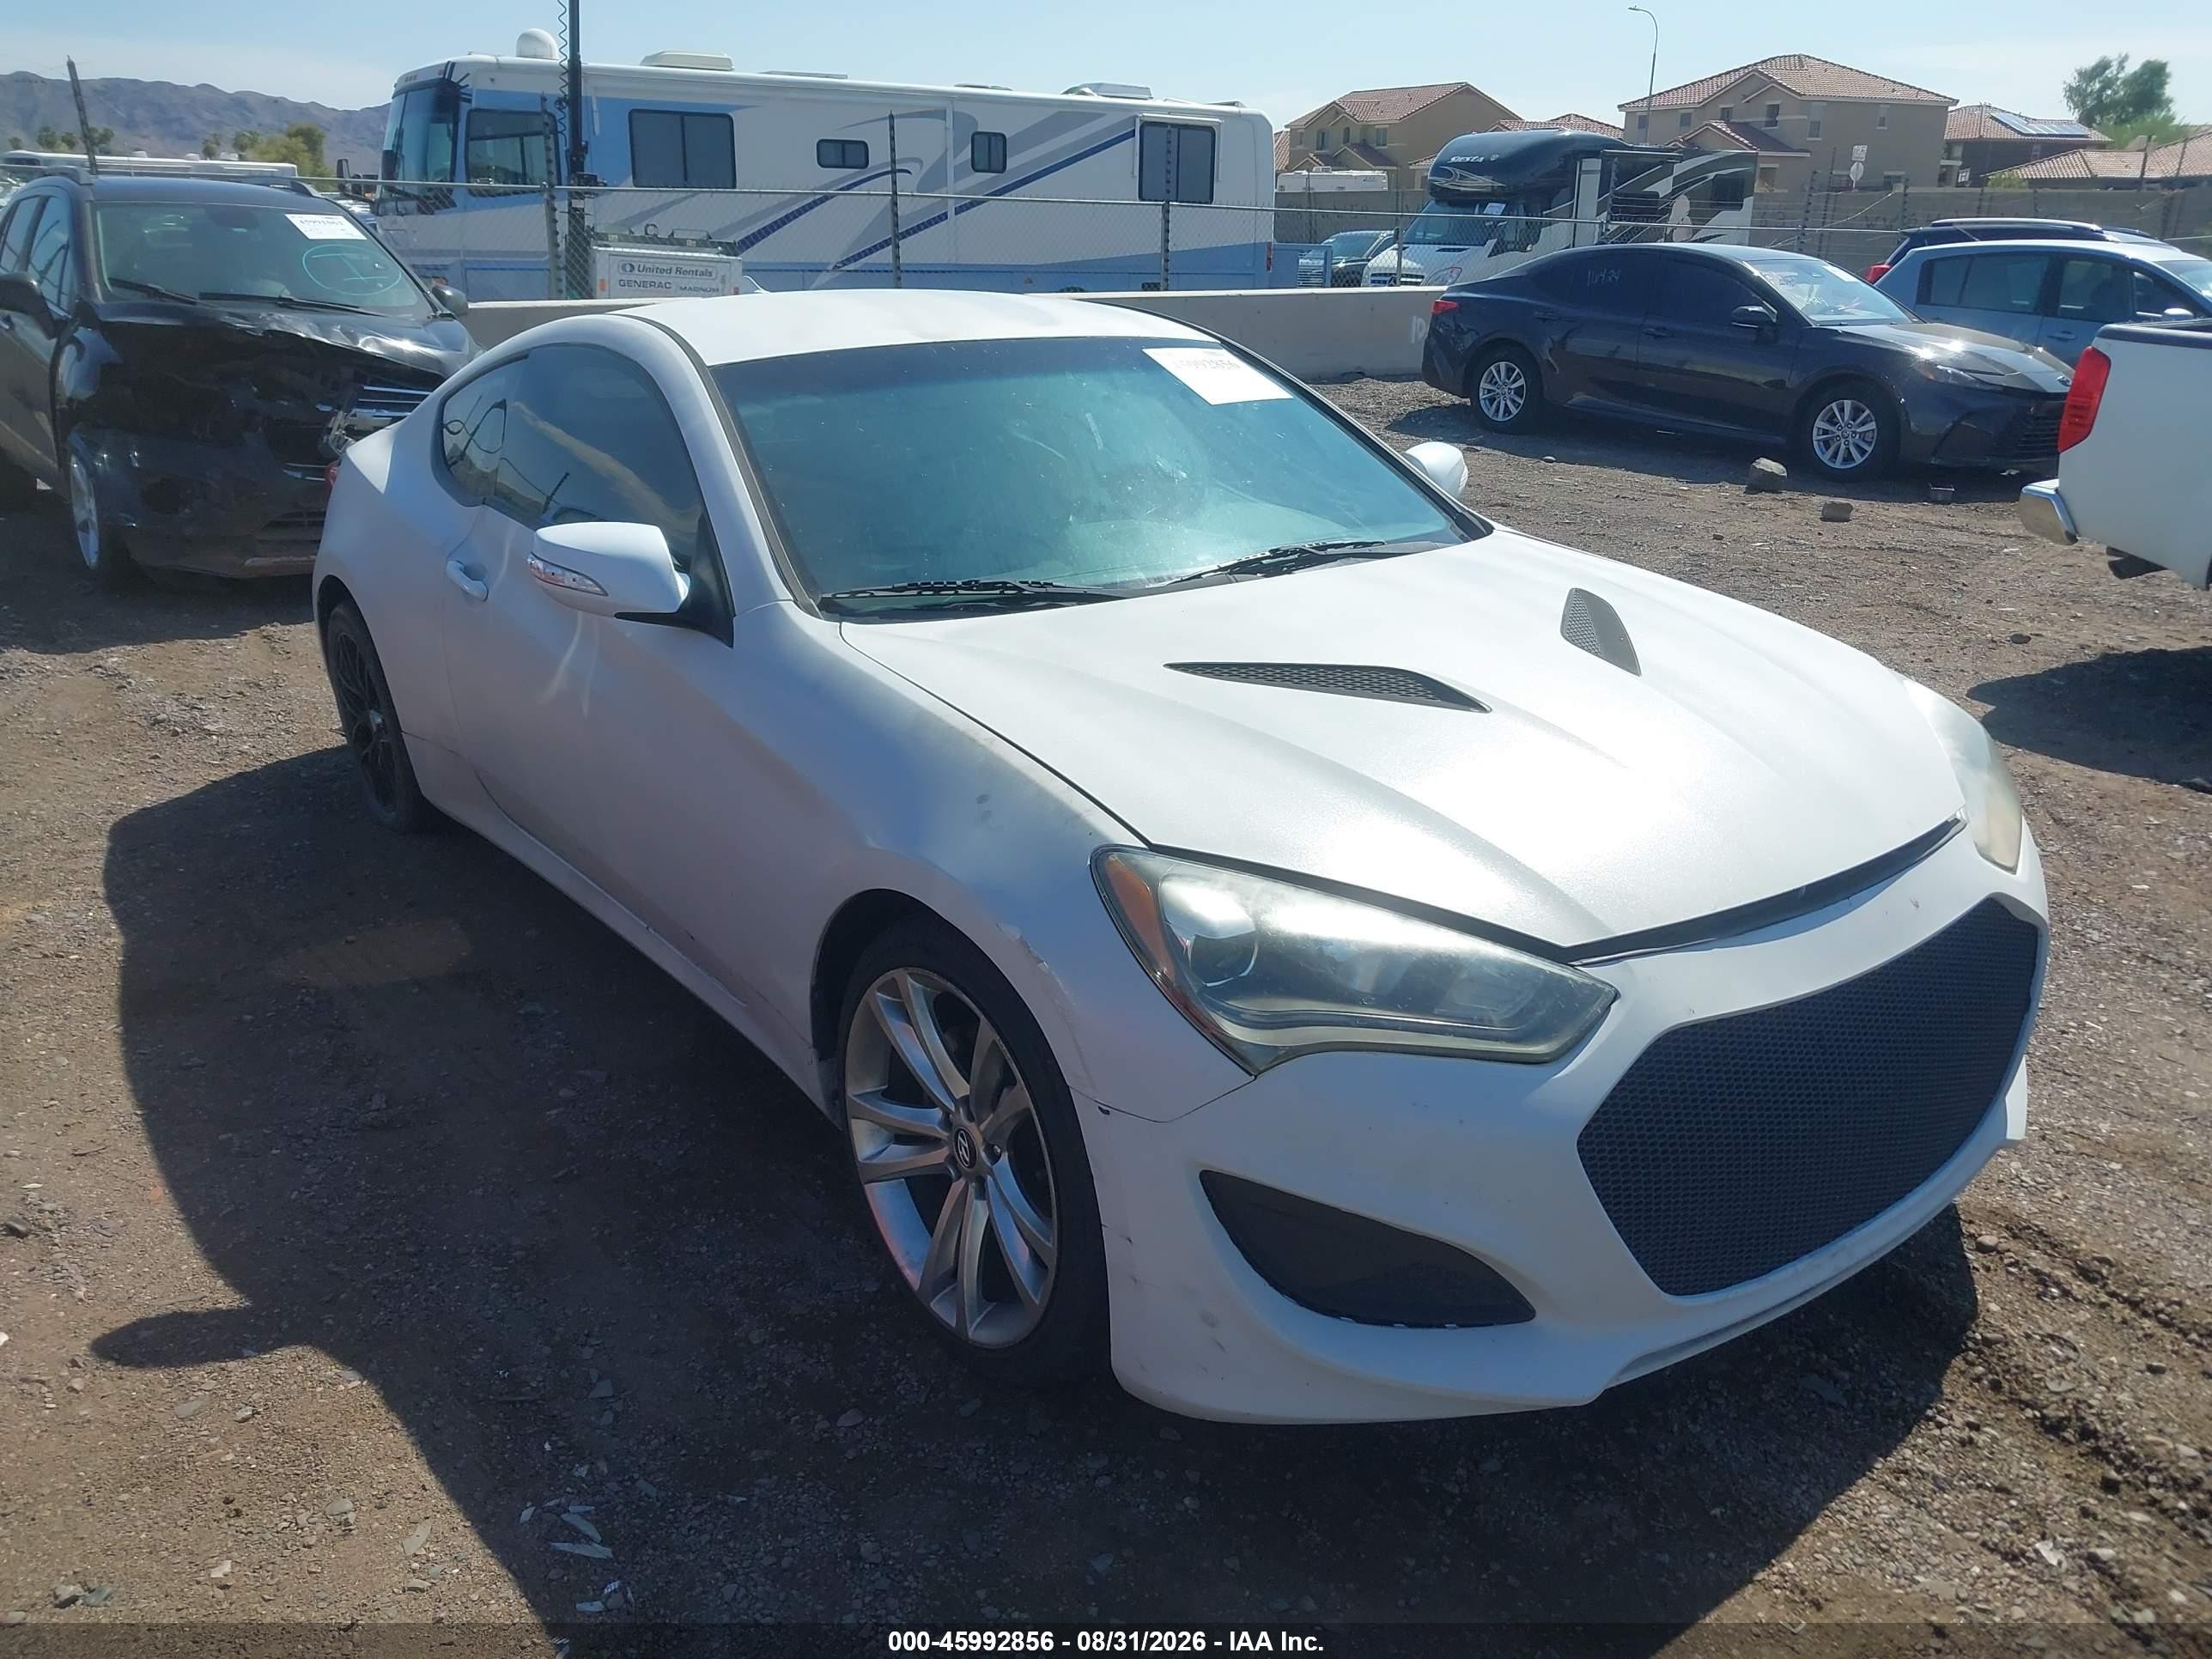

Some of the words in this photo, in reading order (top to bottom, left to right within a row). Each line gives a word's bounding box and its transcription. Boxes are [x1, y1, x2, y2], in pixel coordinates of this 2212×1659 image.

[637, 264, 672, 275] United
[675, 266, 713, 277] Rentals
[618, 279, 672, 289] GENERAC
